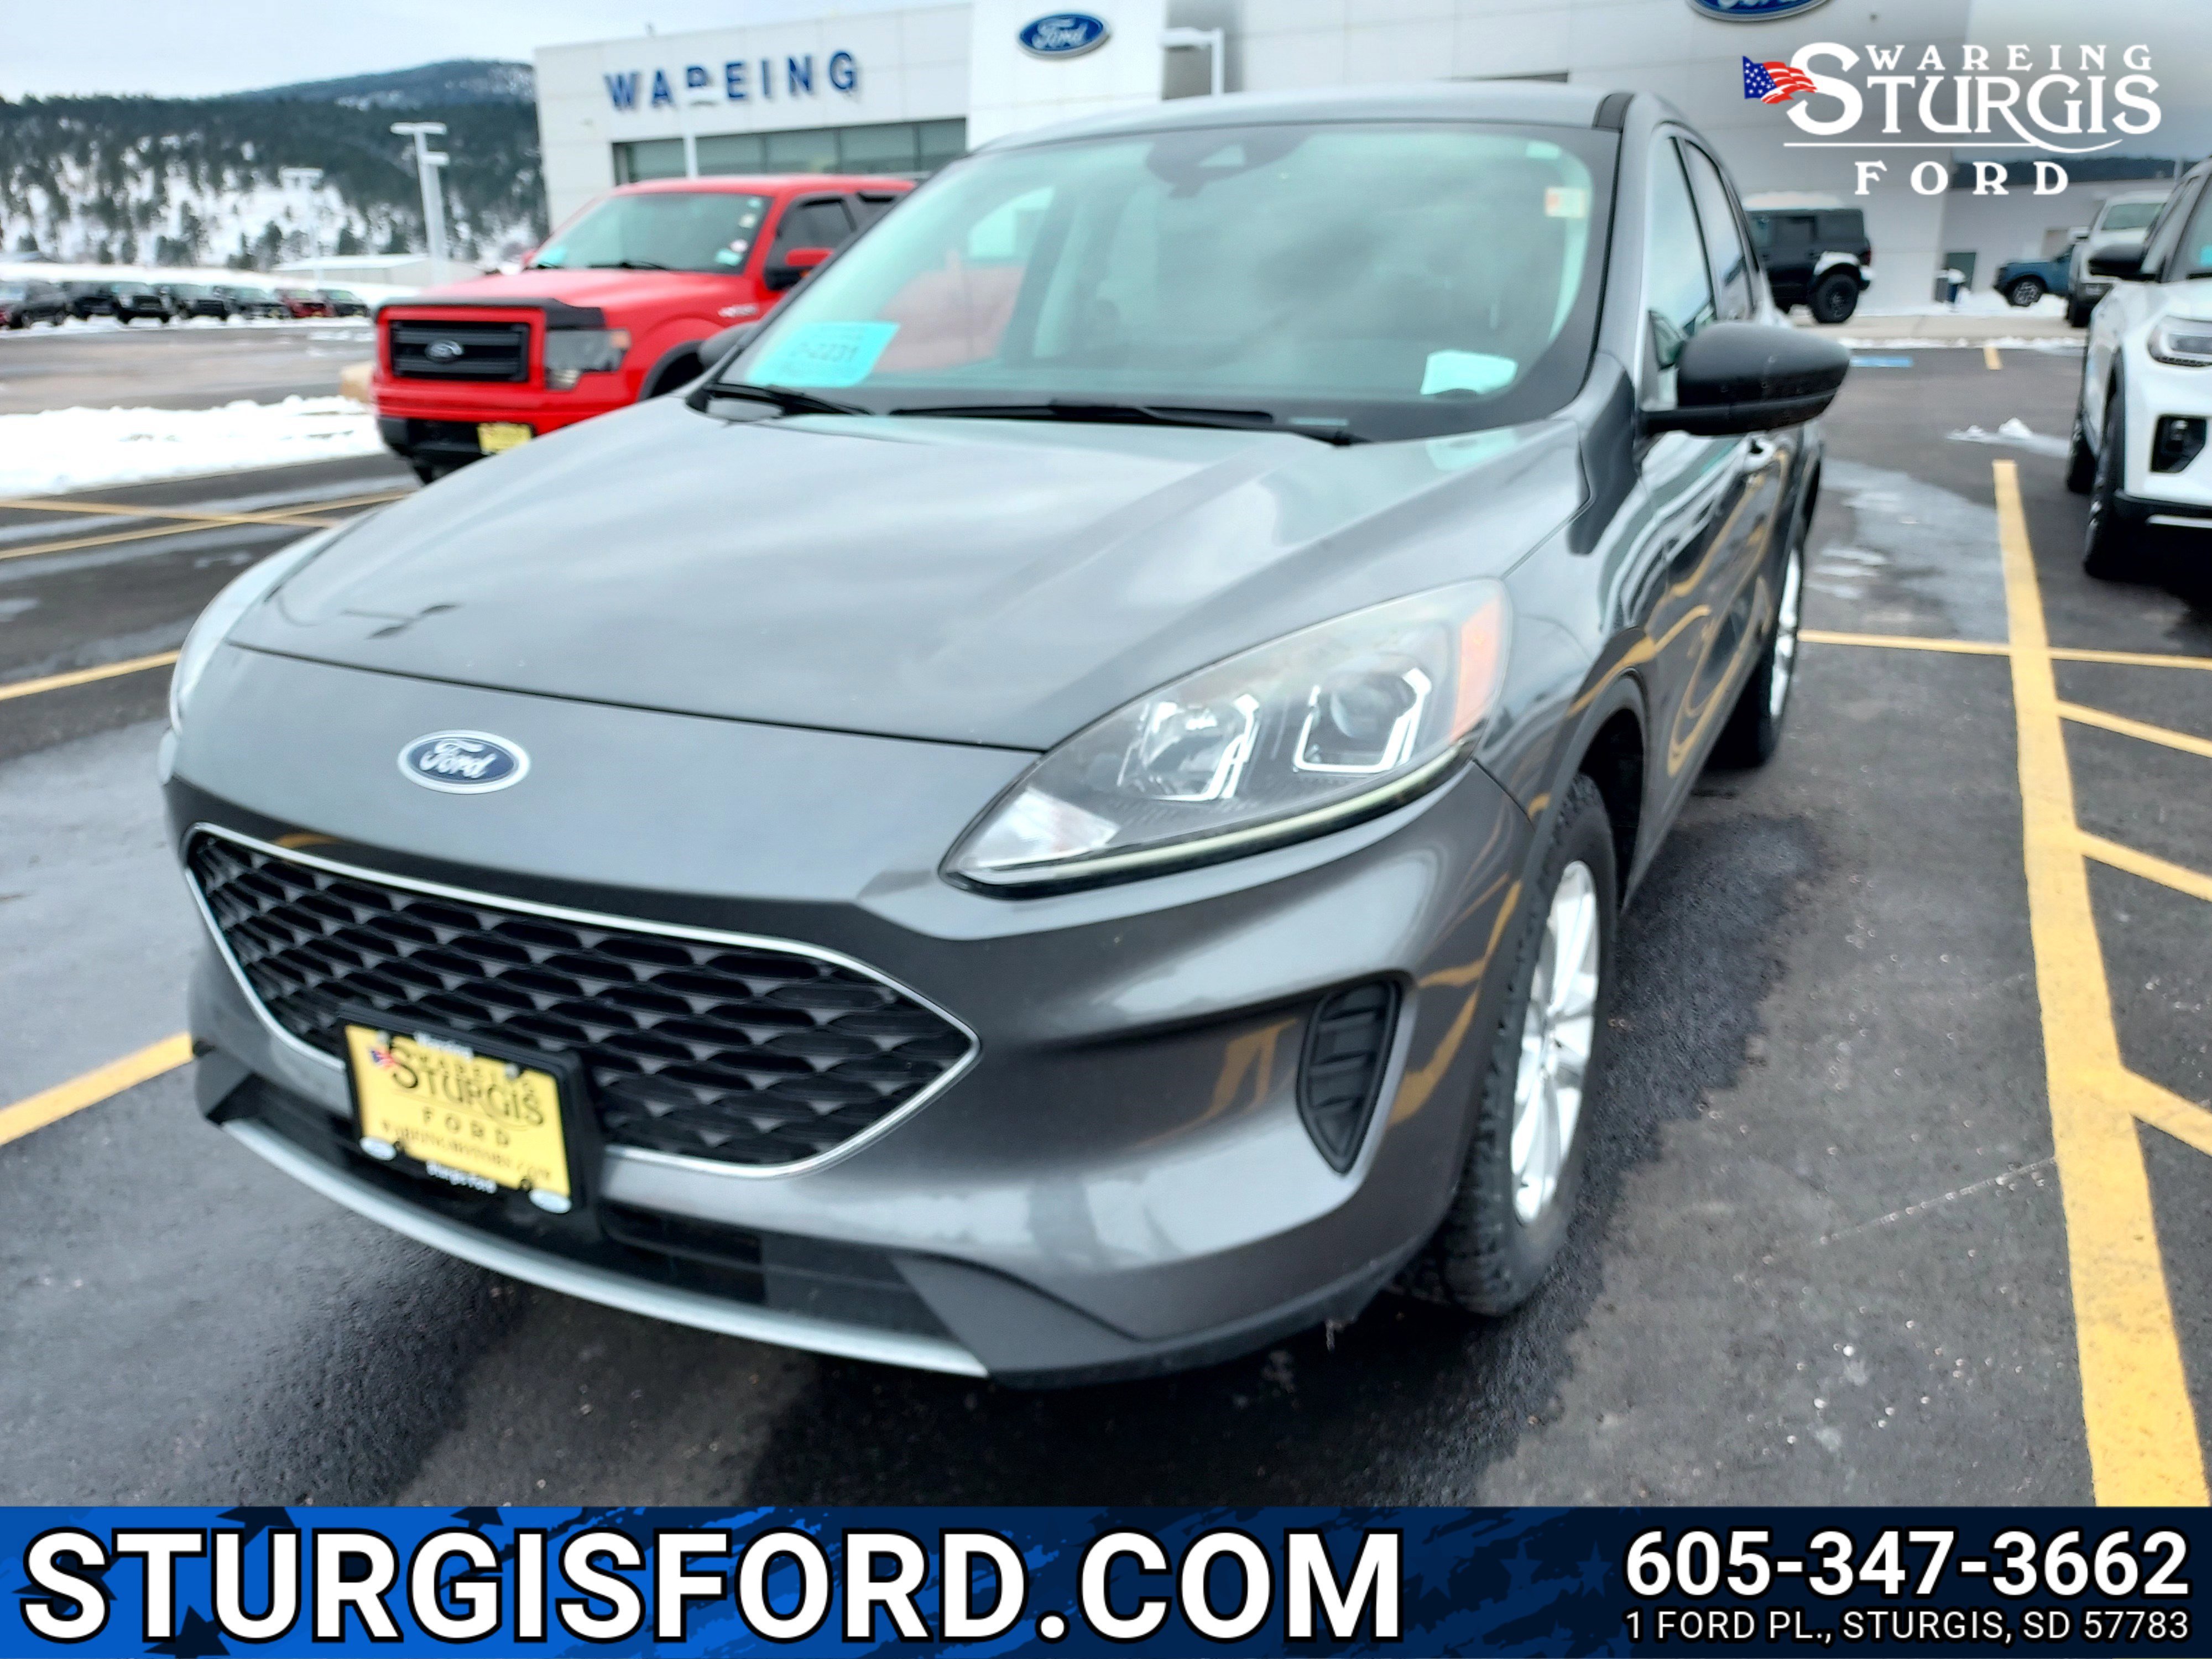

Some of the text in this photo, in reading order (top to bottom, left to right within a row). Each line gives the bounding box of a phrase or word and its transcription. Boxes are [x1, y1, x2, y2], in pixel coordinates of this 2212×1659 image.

[1031, 18, 1088, 49] Ford
[419, 739, 497, 779] Ford
[389, 1044, 544, 1126] STURGIS
[422, 1107, 510, 1147] FORD
